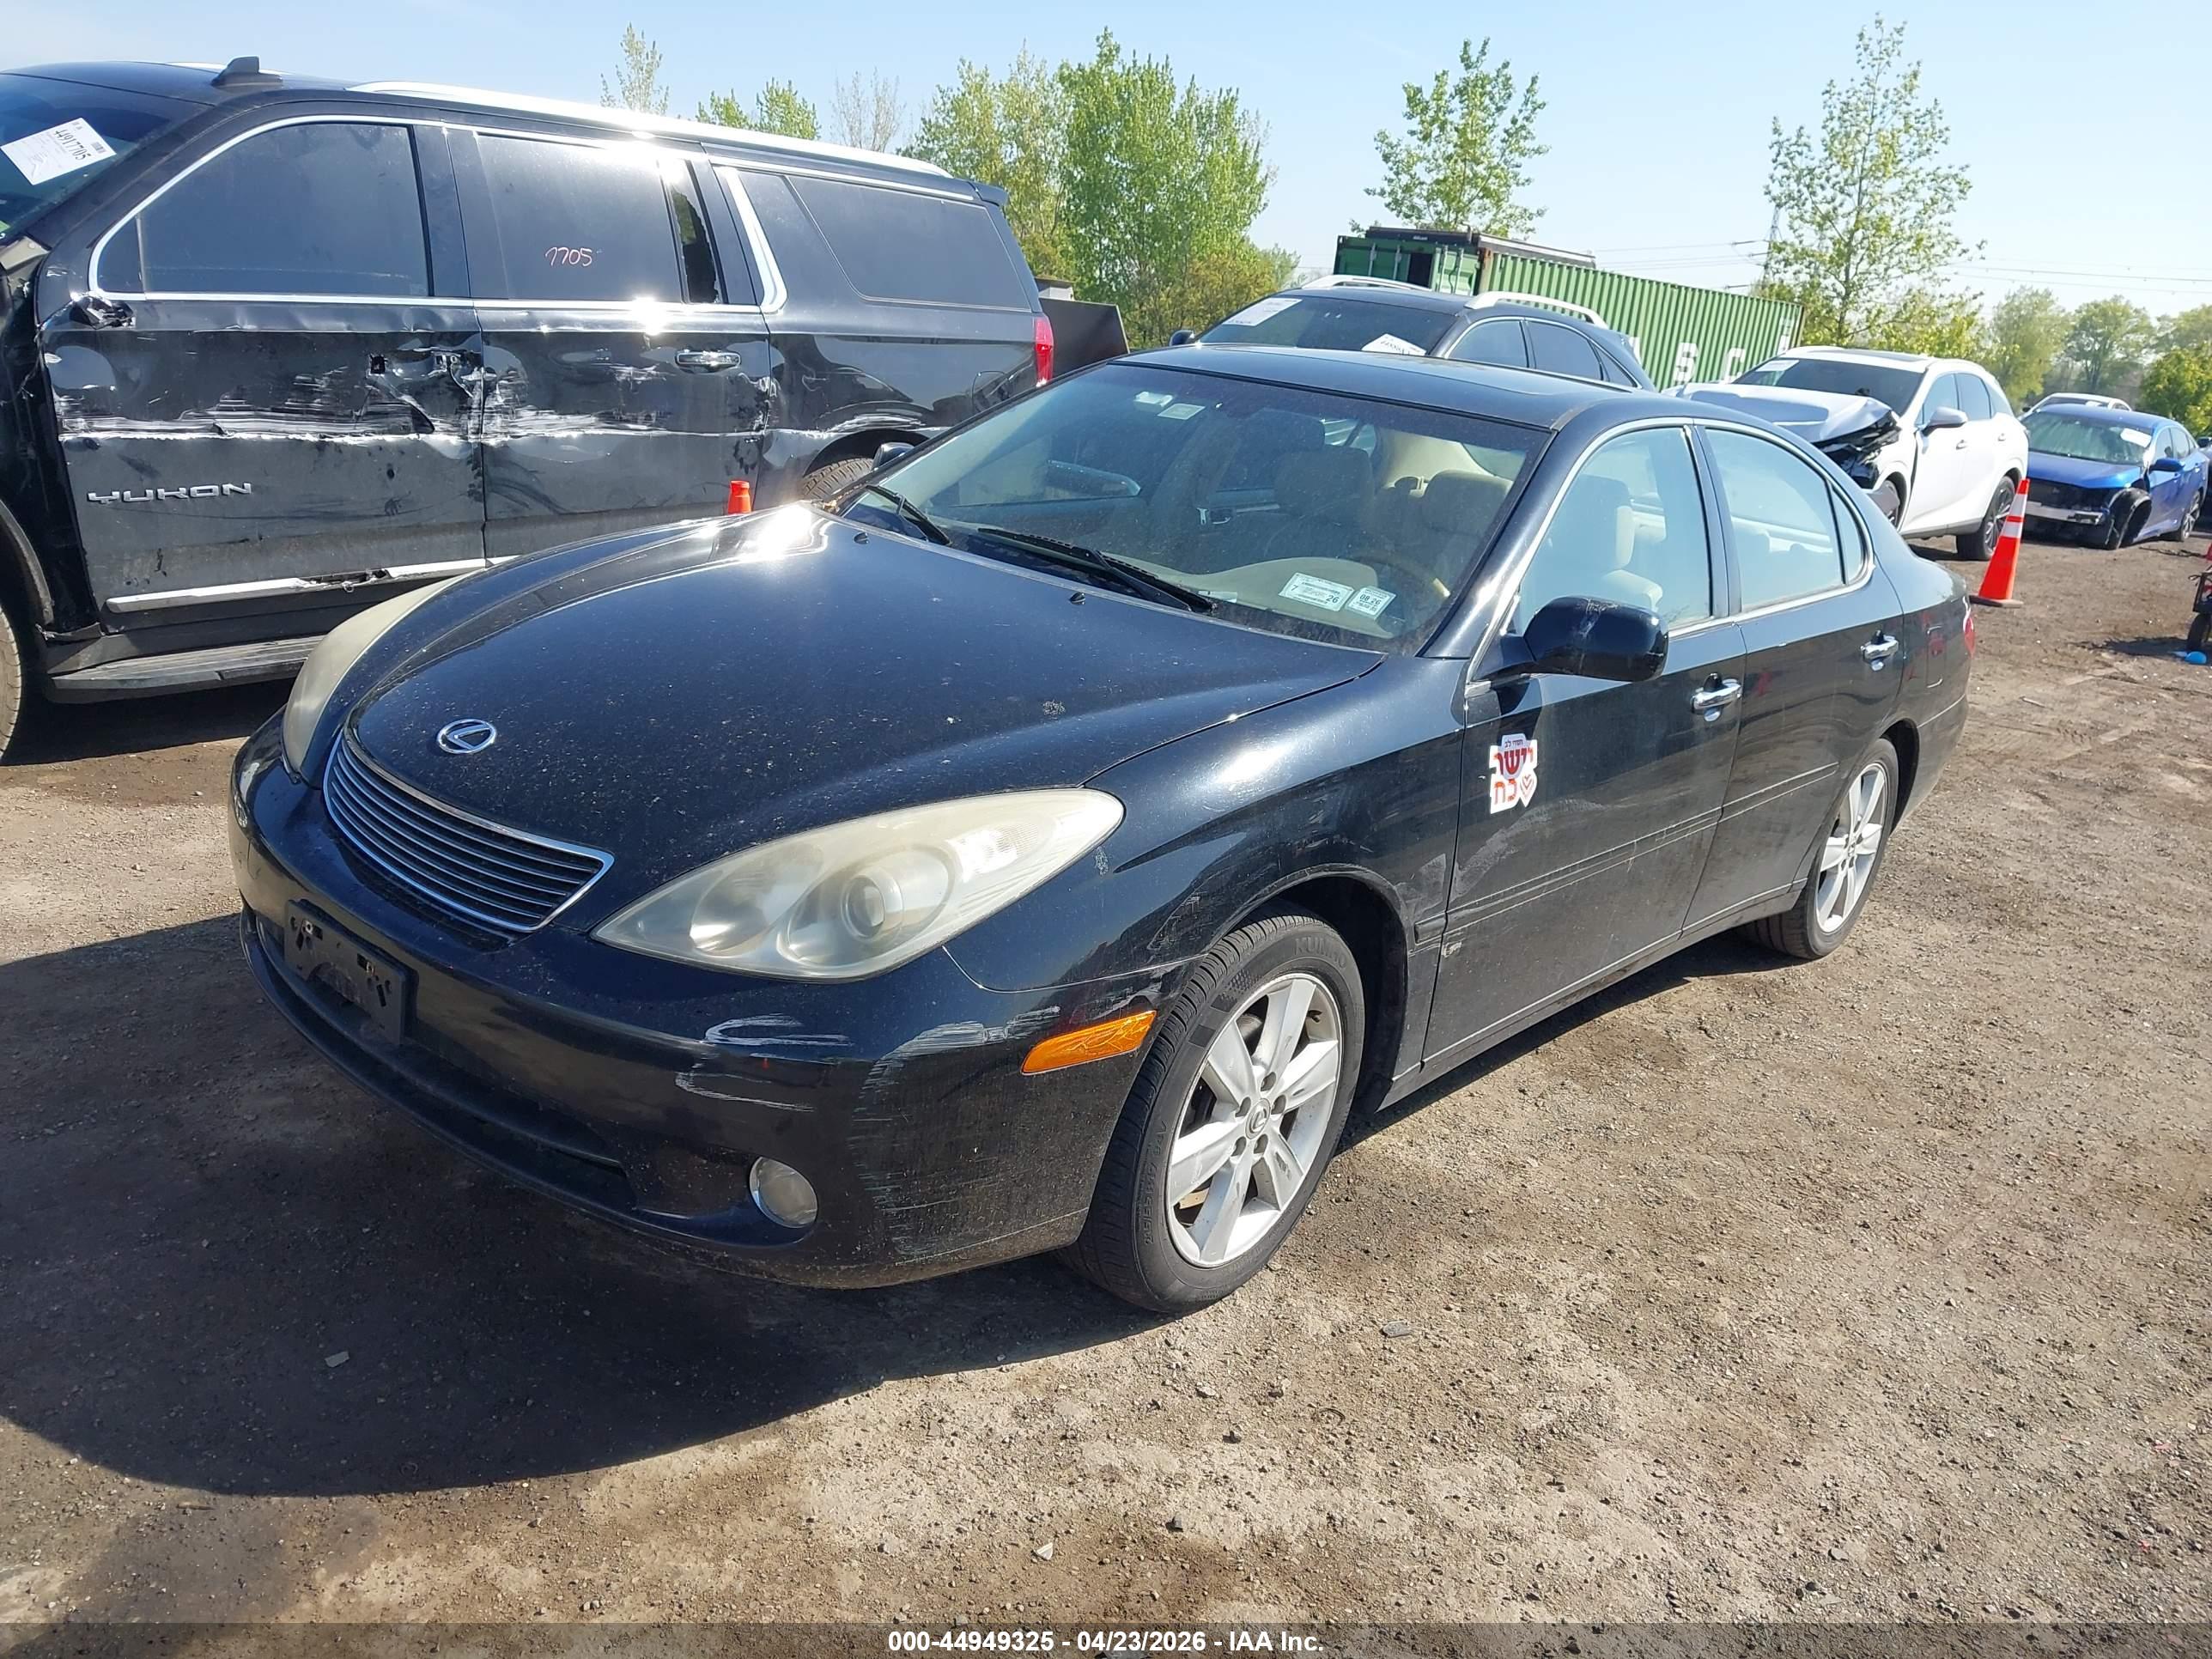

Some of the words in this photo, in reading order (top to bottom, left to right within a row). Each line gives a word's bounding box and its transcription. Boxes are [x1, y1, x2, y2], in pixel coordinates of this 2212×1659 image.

[54, 129, 92, 161] 44917705
[88, 483, 252, 504] YUKON
[1326, 594, 1340, 604] 26
